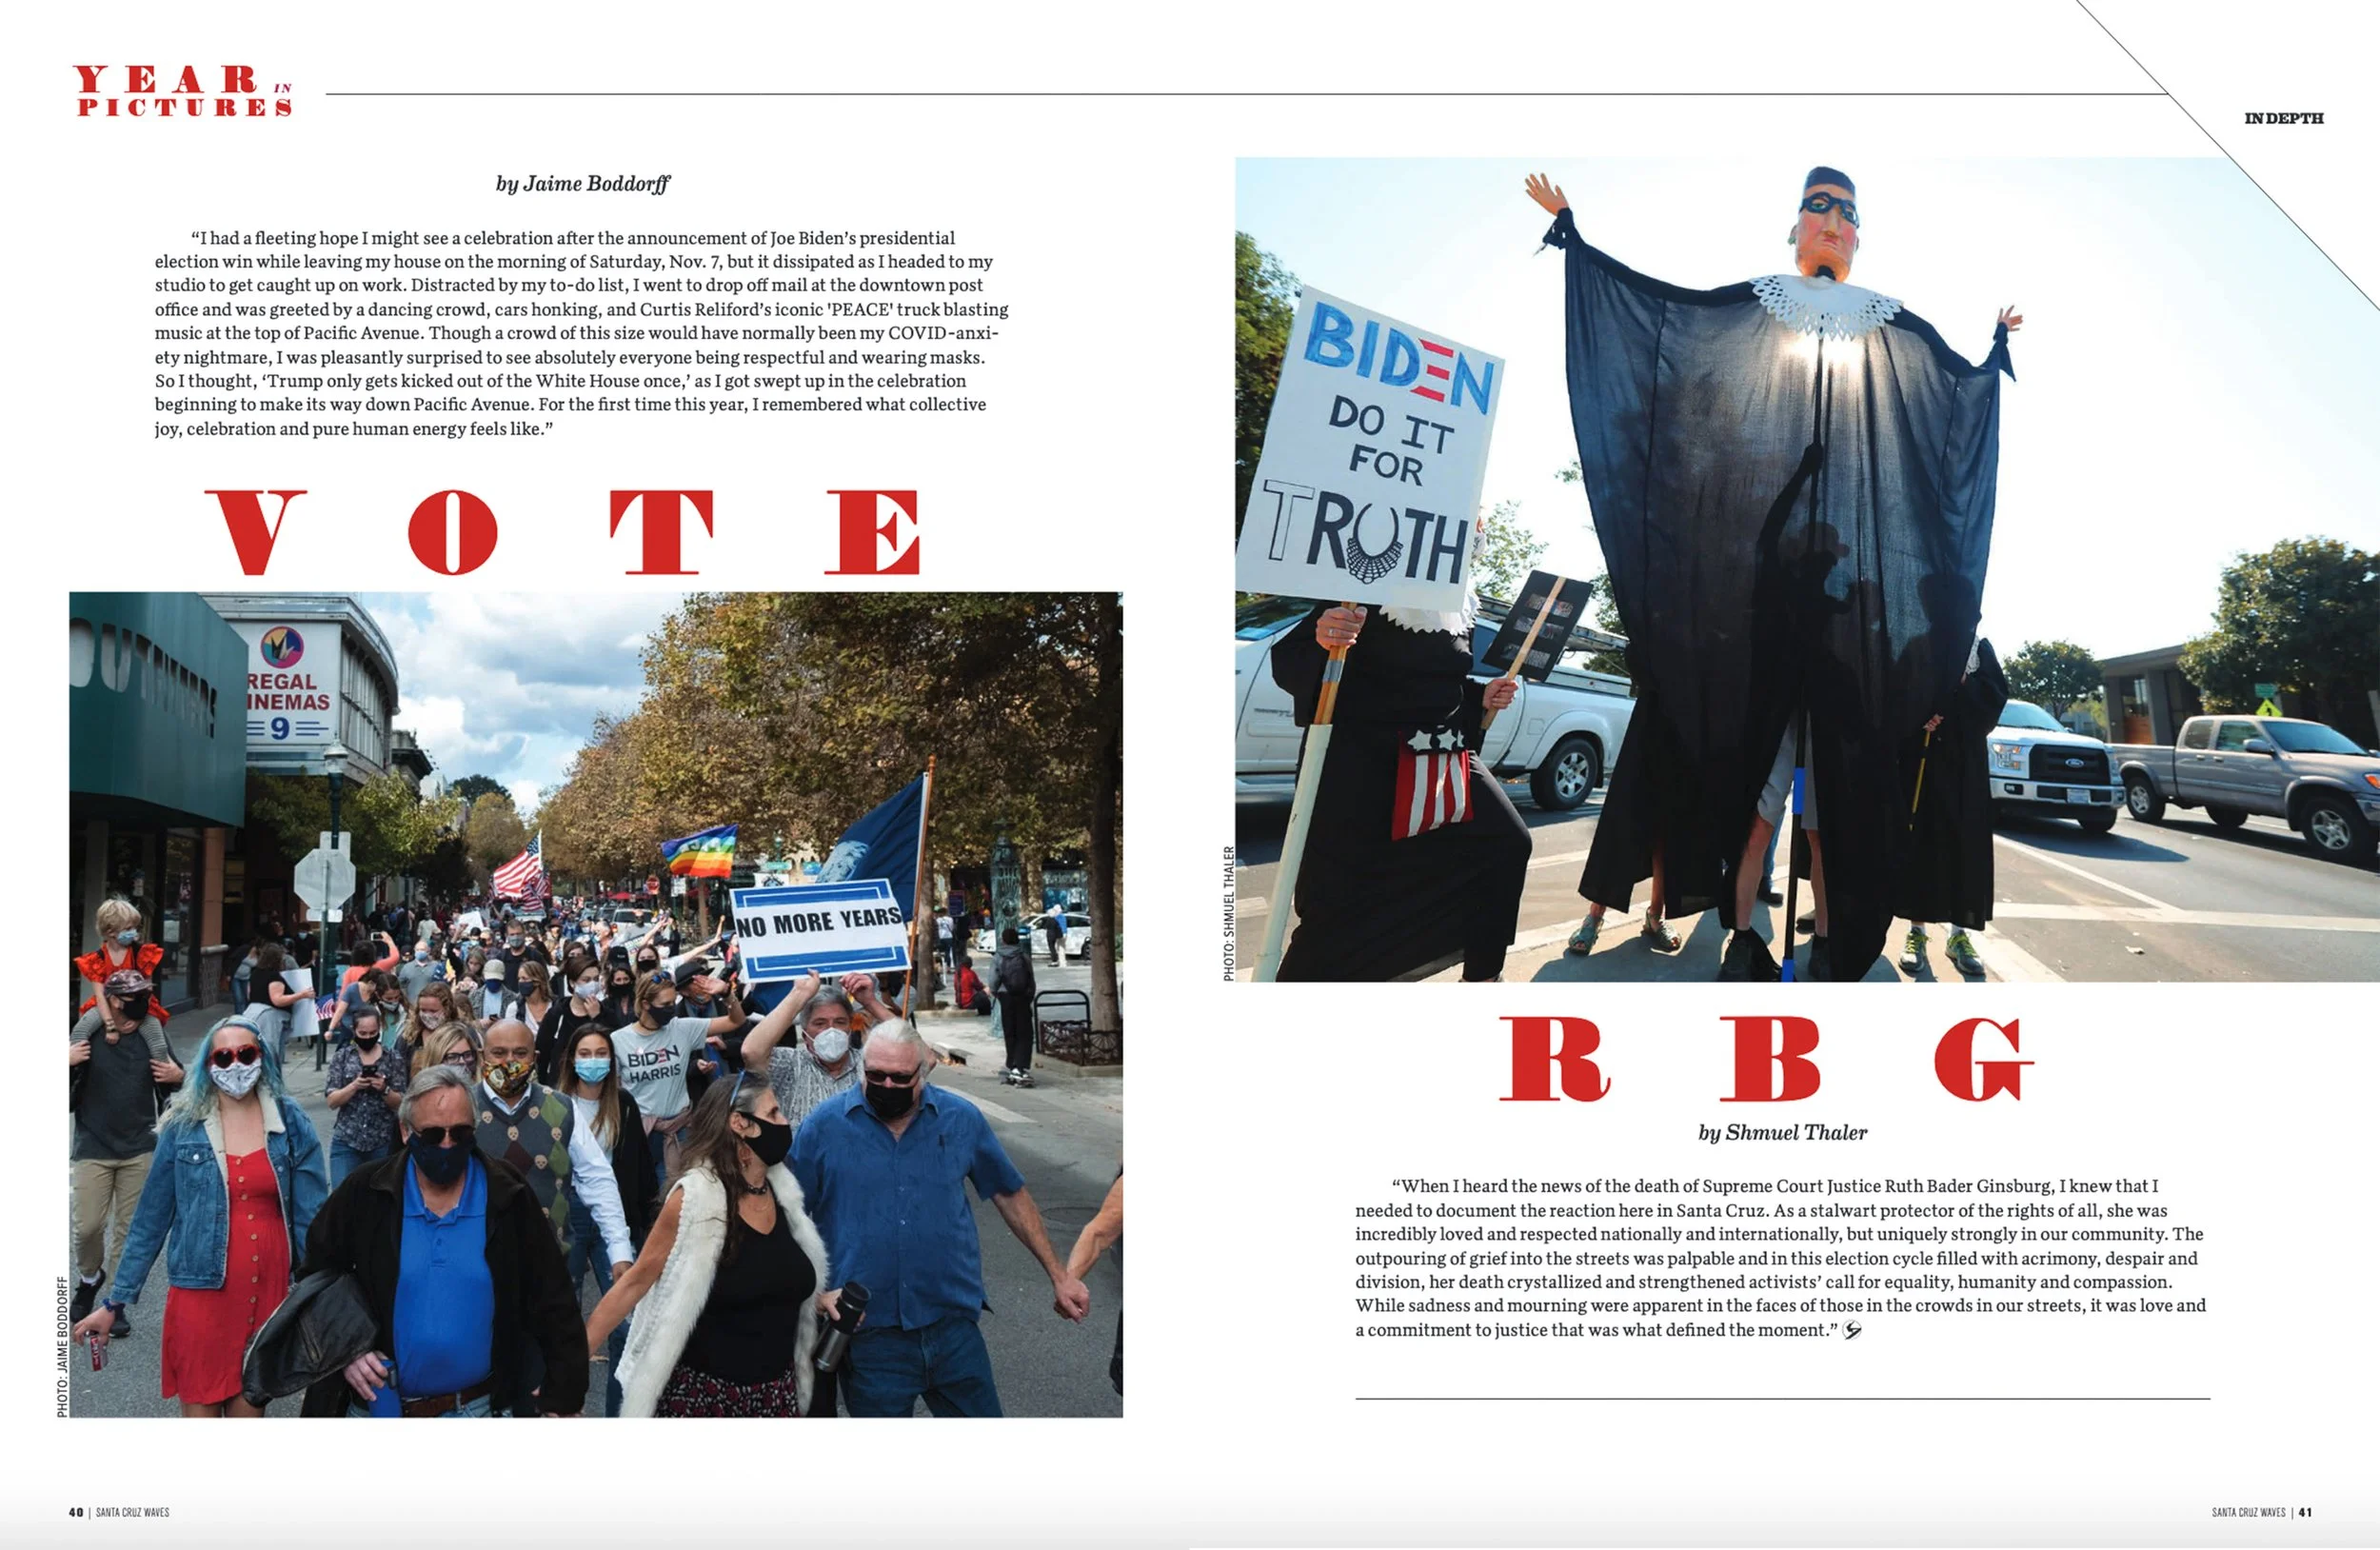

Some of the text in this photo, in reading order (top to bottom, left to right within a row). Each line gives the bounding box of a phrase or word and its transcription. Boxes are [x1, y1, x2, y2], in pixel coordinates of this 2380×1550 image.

[73, 66, 291, 93] YEAR IN
[77, 98, 292, 117] PICTURES
[2245, 112, 2325, 125] IN DEPTH
[496, 174, 672, 196] by Jaime Boddorff
[209, 229, 240, 246] had
[243, 234, 252, 246] a
[255, 229, 317, 249] fleeting
[319, 230, 359, 249] hope
[362, 230, 368, 246] I
[371, 230, 420, 249] might
[423, 234, 449, 246] see
[451, 234, 462, 246] a
[464, 230, 554, 246] celebration
[556, 230, 595, 246] after
[597, 230, 625, 246] the
[626, 230, 747, 246] announcement
[750, 230, 768, 246] of
[770, 230, 796, 248] Joe
[859, 229, 956, 249] presidential
[154, 325, 1000, 344] music at the top of Pacific Avenue. Though a crowd of this size would have normally been my COVID-anxi-
[1302, 301, 1496, 416] BIDEN
[154, 396, 986, 415] beginning to make its way down Pacific Avenue. For the first time this year, I remembered what collective
[154, 421, 183, 440] joy,
[187, 421, 276, 436] celebration
[279, 421, 310, 436] and
[312, 425, 350, 440] pure
[352, 421, 409, 436] human
[412, 424, 467, 440] energy
[469, 421, 507, 436] feels
[1329, 394, 1455, 454] DO IT
[1348, 444, 1424, 487] FOR
[204, 488, 921, 577] VOTE
[1263, 479, 1470, 586] TRUTH
[247, 673, 318, 689] REGAL
[247, 694, 330, 710] INEMAS
[271, 717, 289, 741] 9
[736, 906, 902, 938] NO MORE YEARS
[1222, 846, 1235, 982] PHOTO: SHMUEL THALER
[627, 1044, 680, 1067] BIDEN
[1498, 1015, 2035, 1103] RBG
[629, 1063, 682, 1083] HARRIS
[1698, 1123, 1869, 1145] by Shmuel Thaler
[1453, 1179, 1459, 1193] I
[1462, 1178, 1509, 1193] heard
[1511, 1178, 1538, 1193] the
[1540, 1182, 1582, 1194] news
[1585, 1178, 1603, 1194] of
[1604, 1178, 1632, 1194] the
[1634, 1178, 1680, 1193] death
[1682, 1178, 1700, 1194] of
[1702, 1179, 1773, 1197] Supreme
[1776, 1179, 1824, 1194] Court
[1827, 1178, 1881, 1197] Justice
[1884, 1178, 1925, 1194] Ruth
[1927, 1178, 1973, 1193] Bader
[1976, 1178, 2055, 1197] Ginsburg,
[2059, 1179, 2066, 1193] I
[2069, 1178, 2113, 1193] knew
[2115, 1178, 2150, 1193] that
[2152, 1179, 2159, 1193] I
[1356, 1225, 2204, 1245] incredibly loved and respected nationally and internationally, but uniquely strongly in our community. The
[1356, 1274, 1425, 1292] division,
[1429, 1274, 1456, 1289] her
[1458, 1274, 1505, 1289] death
[1507, 1274, 1603, 1293] crystallized
[1605, 1274, 1636, 1289] and
[1638, 1274, 1746, 1293] strengthened
[1825, 1274, 1855, 1289] call
[1857, 1274, 1881, 1289] for
[1884, 1274, 1954, 1293] equality,
[1957, 1274, 2037, 1293] humanity
[2040, 1274, 2071, 1289] and
[2073, 1274, 2172, 1293] compassion.
[56, 1276, 69, 1419] PHOTO: JAIME BODDORFF
[69, 1507, 169, 1518] 40 SANTA CRUZ WAVES
[2211, 1507, 2311, 1518] SANTA CRUZ WAVES 41
